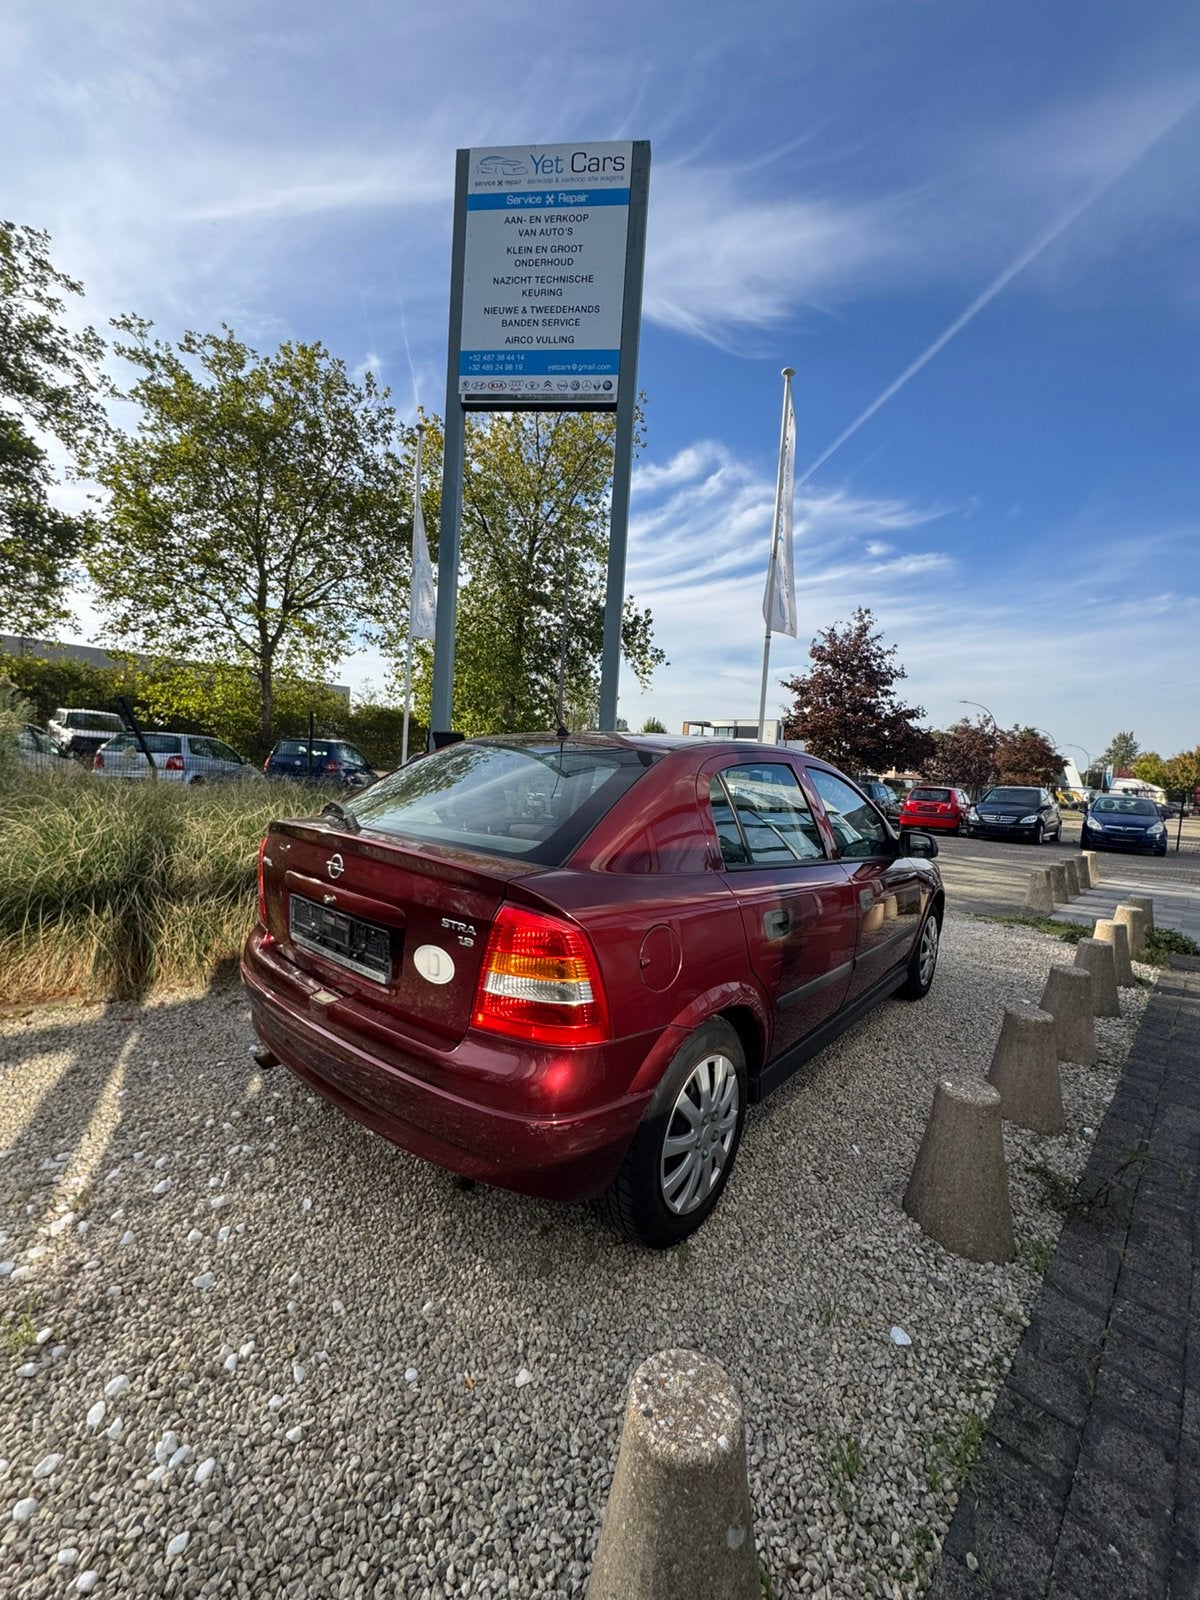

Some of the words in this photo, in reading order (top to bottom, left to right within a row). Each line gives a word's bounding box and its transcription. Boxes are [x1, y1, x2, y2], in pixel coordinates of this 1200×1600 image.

[530, 153, 564, 175] Yet
[571, 152, 625, 173] Cars
[504, 178, 522, 186] repair
[527, 176, 554, 185] aankoop
[561, 175, 585, 183] verkoop
[600, 174, 625, 183] wagens
[506, 194, 542, 205] Service
[558, 192, 589, 204] Repair
[504, 216, 527, 225] AAN-
[529, 215, 542, 224] EN
[544, 213, 589, 223] VERKOOP
[518, 228, 537, 237] VAN
[539, 227, 574, 236] AUTO'S
[506, 246, 533, 255] KLEIN
[536, 245, 548, 254] EN
[550, 244, 584, 253] GROOT
[514, 257, 574, 267] ONDERHOUD
[493, 275, 533, 285] NAZICHT
[534, 274, 594, 284] TECHNISCHE
[521, 288, 563, 297] KEURING
[483, 306, 519, 315] NIEUWE
[522, 306, 527, 314] &
[530, 304, 601, 314] TWEEDEHANDS
[501, 318, 539, 328] BANDEN
[541, 318, 581, 327] SERVICE
[505, 336, 534, 344] AIRCO
[536, 335, 575, 344] VULLING
[547, 363, 611, 372] yetcars@gmail.com
[441, 917, 477, 936] STRA
